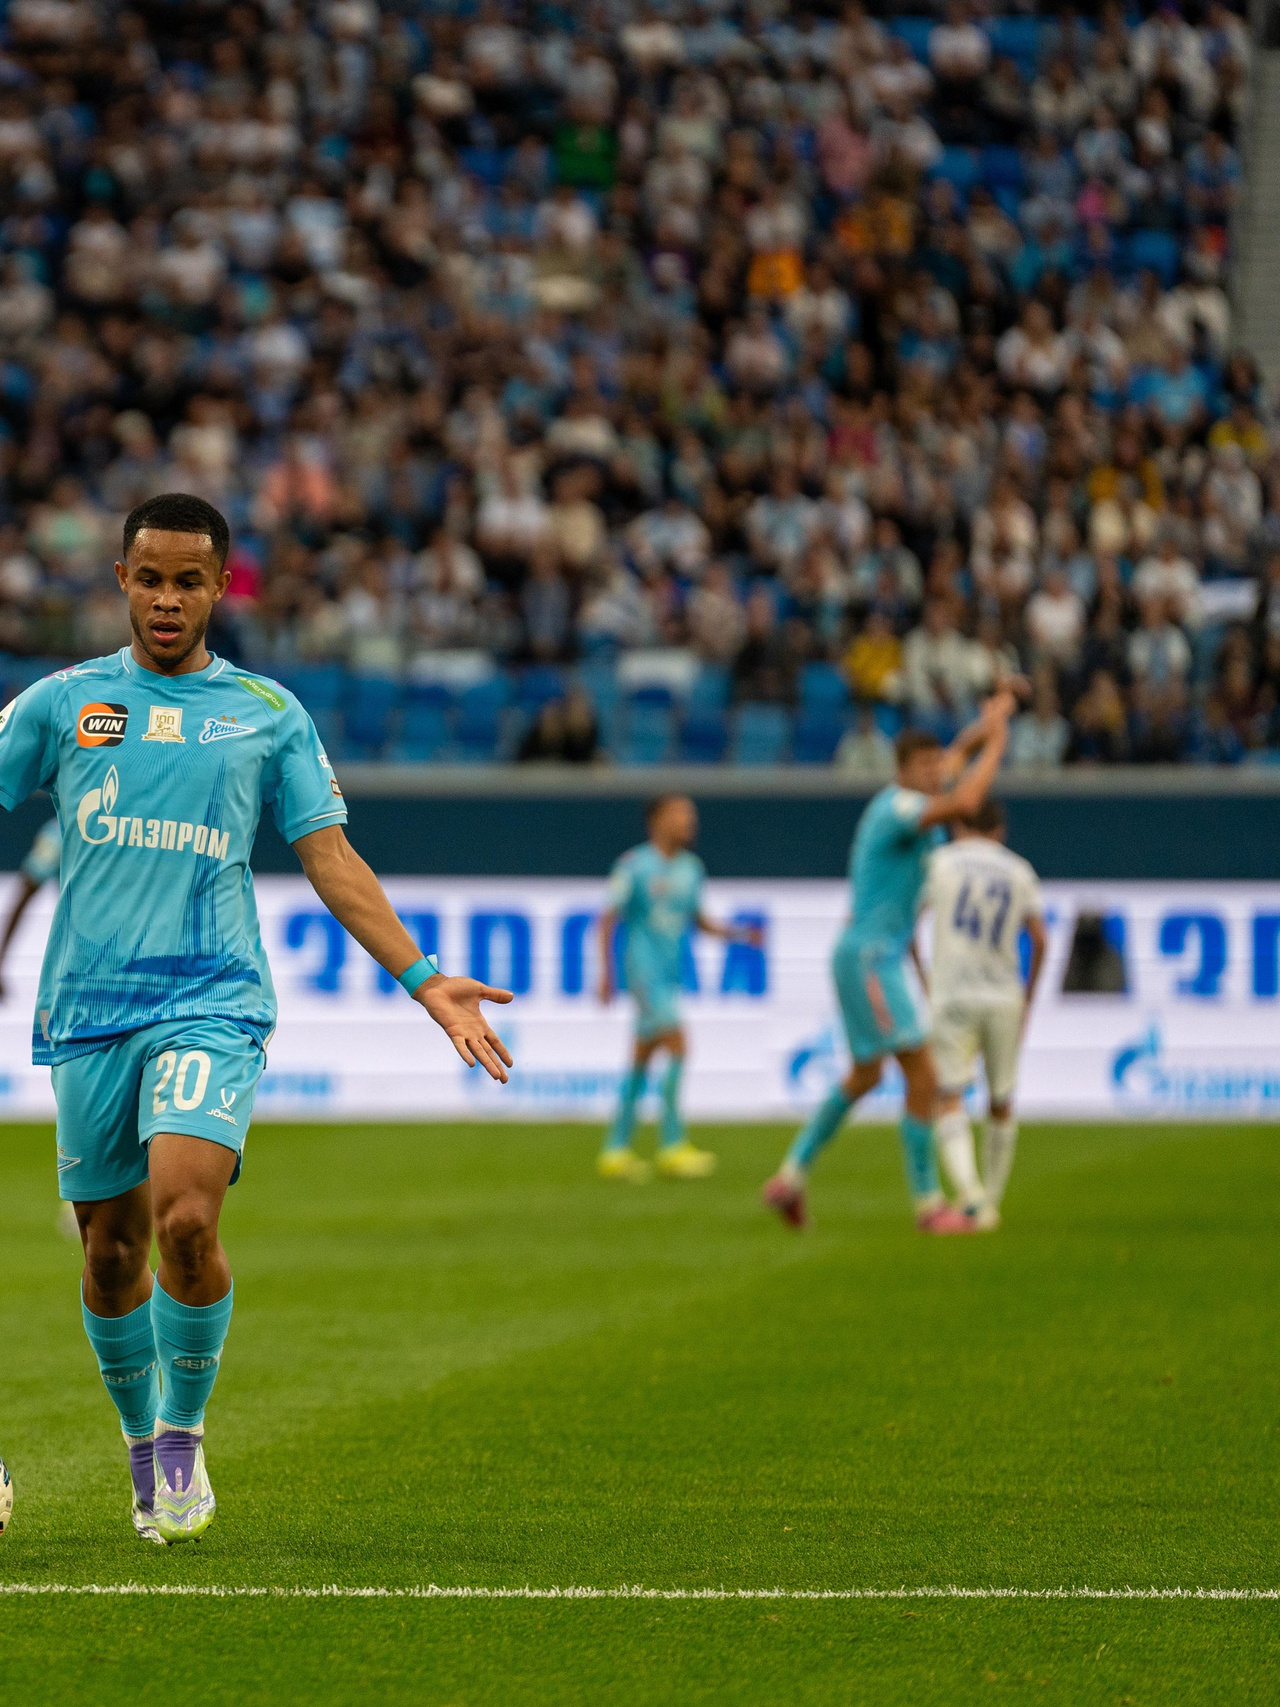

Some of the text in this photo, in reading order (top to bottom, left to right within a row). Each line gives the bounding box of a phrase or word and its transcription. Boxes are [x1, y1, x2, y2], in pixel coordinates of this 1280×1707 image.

[87, 718, 124, 732] WIN
[116, 816, 231, 861] ГАЗПРОМ
[951, 876, 1013, 949] 47
[152, 1050, 211, 1115] 20
